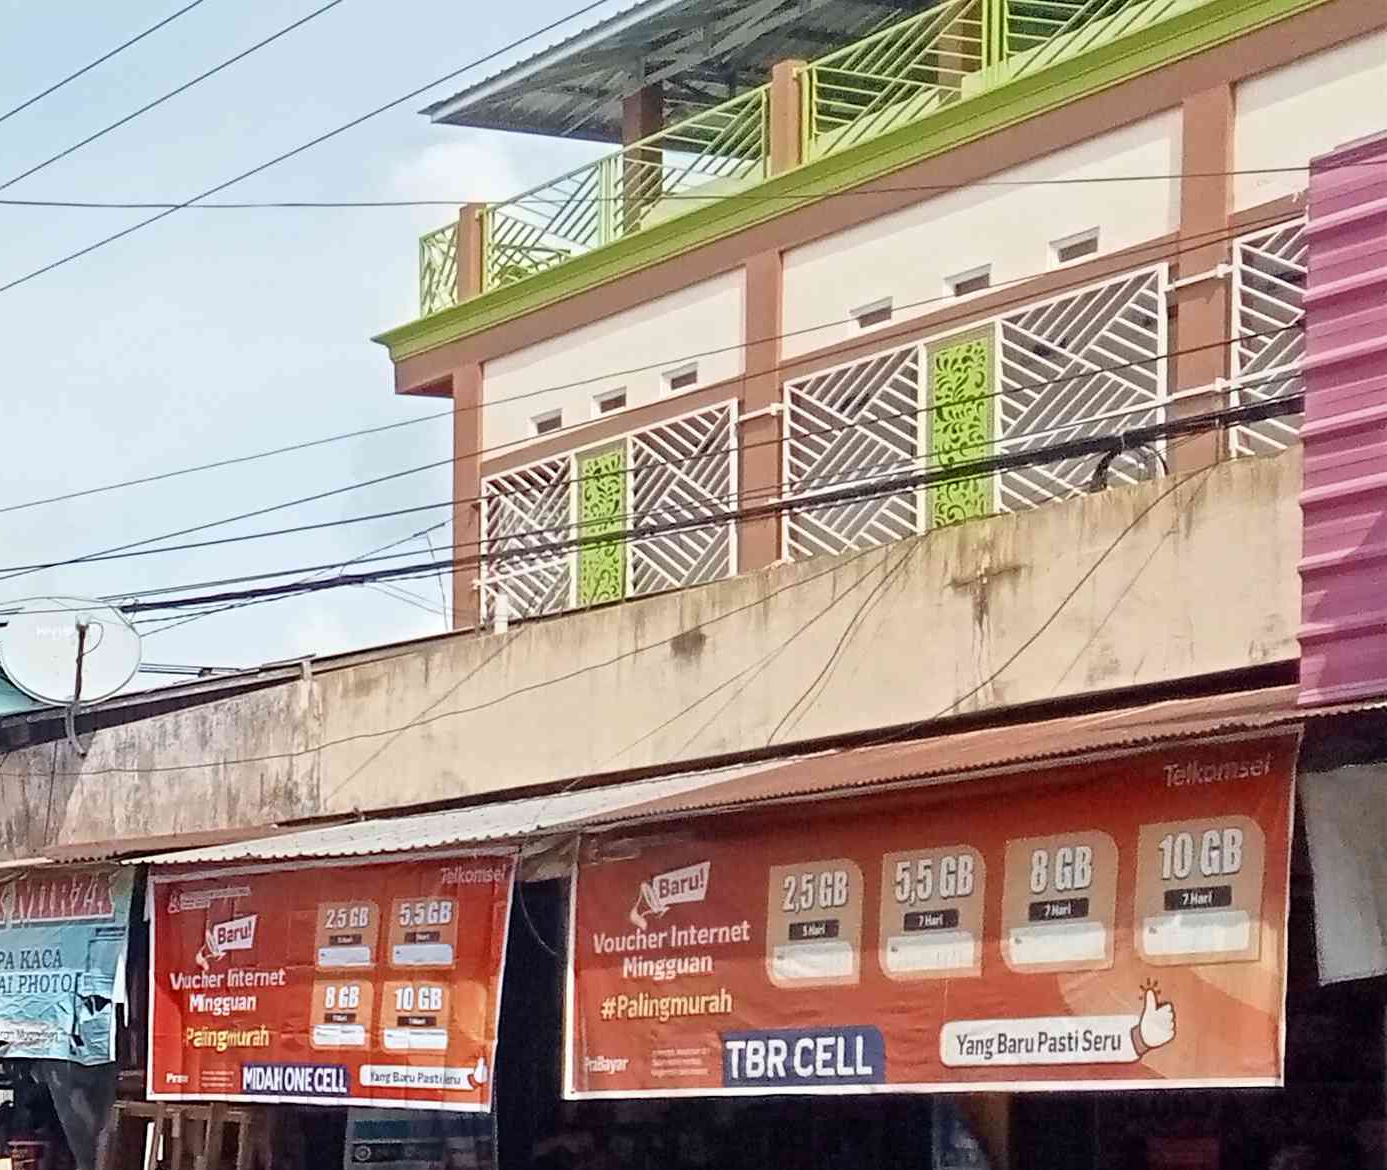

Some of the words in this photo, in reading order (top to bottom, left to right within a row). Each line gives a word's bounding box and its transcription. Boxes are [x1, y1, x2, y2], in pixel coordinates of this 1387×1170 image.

[1163, 754, 1272, 787] Telkomsel
[1158, 833, 1191, 880] 10
[1199, 828, 1243, 876] GB
[441, 864, 506, 884] Telkomsel
[895, 859, 936, 905] 5,5
[939, 854, 974, 899] GB
[1030, 850, 1050, 893] 8
[1055, 845, 1092, 889] GB
[658, 875, 705, 898] Baru!
[783, 873, 814, 914] 2,5
[818, 870, 849, 908] GB
[349, 907, 370, 927] GB
[426, 901, 452, 925] GB
[217, 922, 252, 945] Baru!
[593, 932, 666, 954] Voucher
[670, 920, 750, 946] Internet
[20, 948, 63, 969] KACA
[622, 954, 712, 980] Mingguan
[18, 973, 72, 994] PHOTO
[227, 967, 286, 988] Internet
[325, 986, 336, 1009] 8
[339, 985, 360, 1009] GB
[394, 988, 414, 1011] 10
[418, 986, 443, 1011] GB
[600, 988, 732, 1022] #Palingmurah
[956, 1034, 993, 1060] Yang
[997, 1031, 1034, 1055] Baru
[1037, 1029, 1079, 1053] Pasti
[1082, 1028, 1121, 1052] Seru
[727, 1038, 787, 1080] TBR
[793, 1035, 873, 1077] CELL
[242, 1065, 283, 1091] MIDAH
[284, 1067, 316, 1091] ONE
[317, 1067, 348, 1093] CELL
